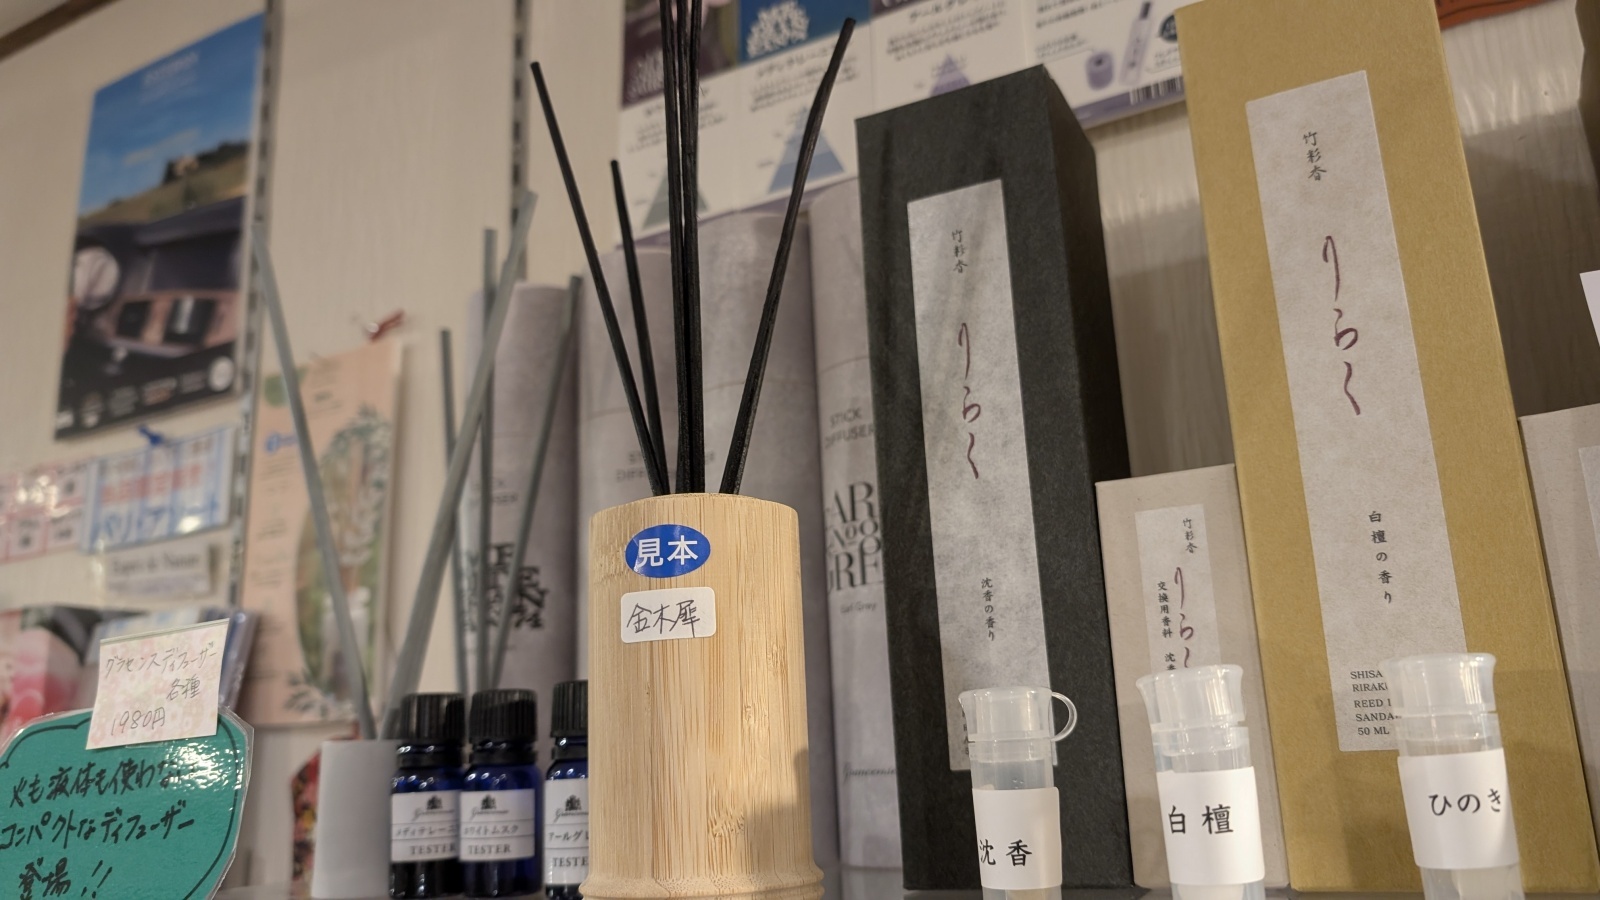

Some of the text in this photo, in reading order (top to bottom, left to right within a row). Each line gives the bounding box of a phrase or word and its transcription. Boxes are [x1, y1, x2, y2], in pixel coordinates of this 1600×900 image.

[1302, 131, 1327, 181] 竹彩香
[1322, 235, 1361, 416] りらく
[957, 322, 981, 480] りらく
[633, 534, 699, 568] 見本
[1368, 510, 1393, 605] 白檀の香り
[626, 599, 701, 638] 金木犀
[981, 577, 996, 642] 沈香の香り
[1157, 580, 1173, 639] 交換用香料
[165, 673, 201, 700] 各種
[1354, 698, 1384, 708] REED
[1355, 712, 1401, 722] SANDA
[110, 706, 166, 737] 1980円
[1357, 726, 1390, 736] 50 ML
[9, 757, 198, 808] 火も液体も使わな
[1428, 788, 1501, 816] ひのき
[1168, 804, 1234, 835] 白檀
[468, 843, 511, 855] TESTER
[979, 838, 1033, 867] 沈香
